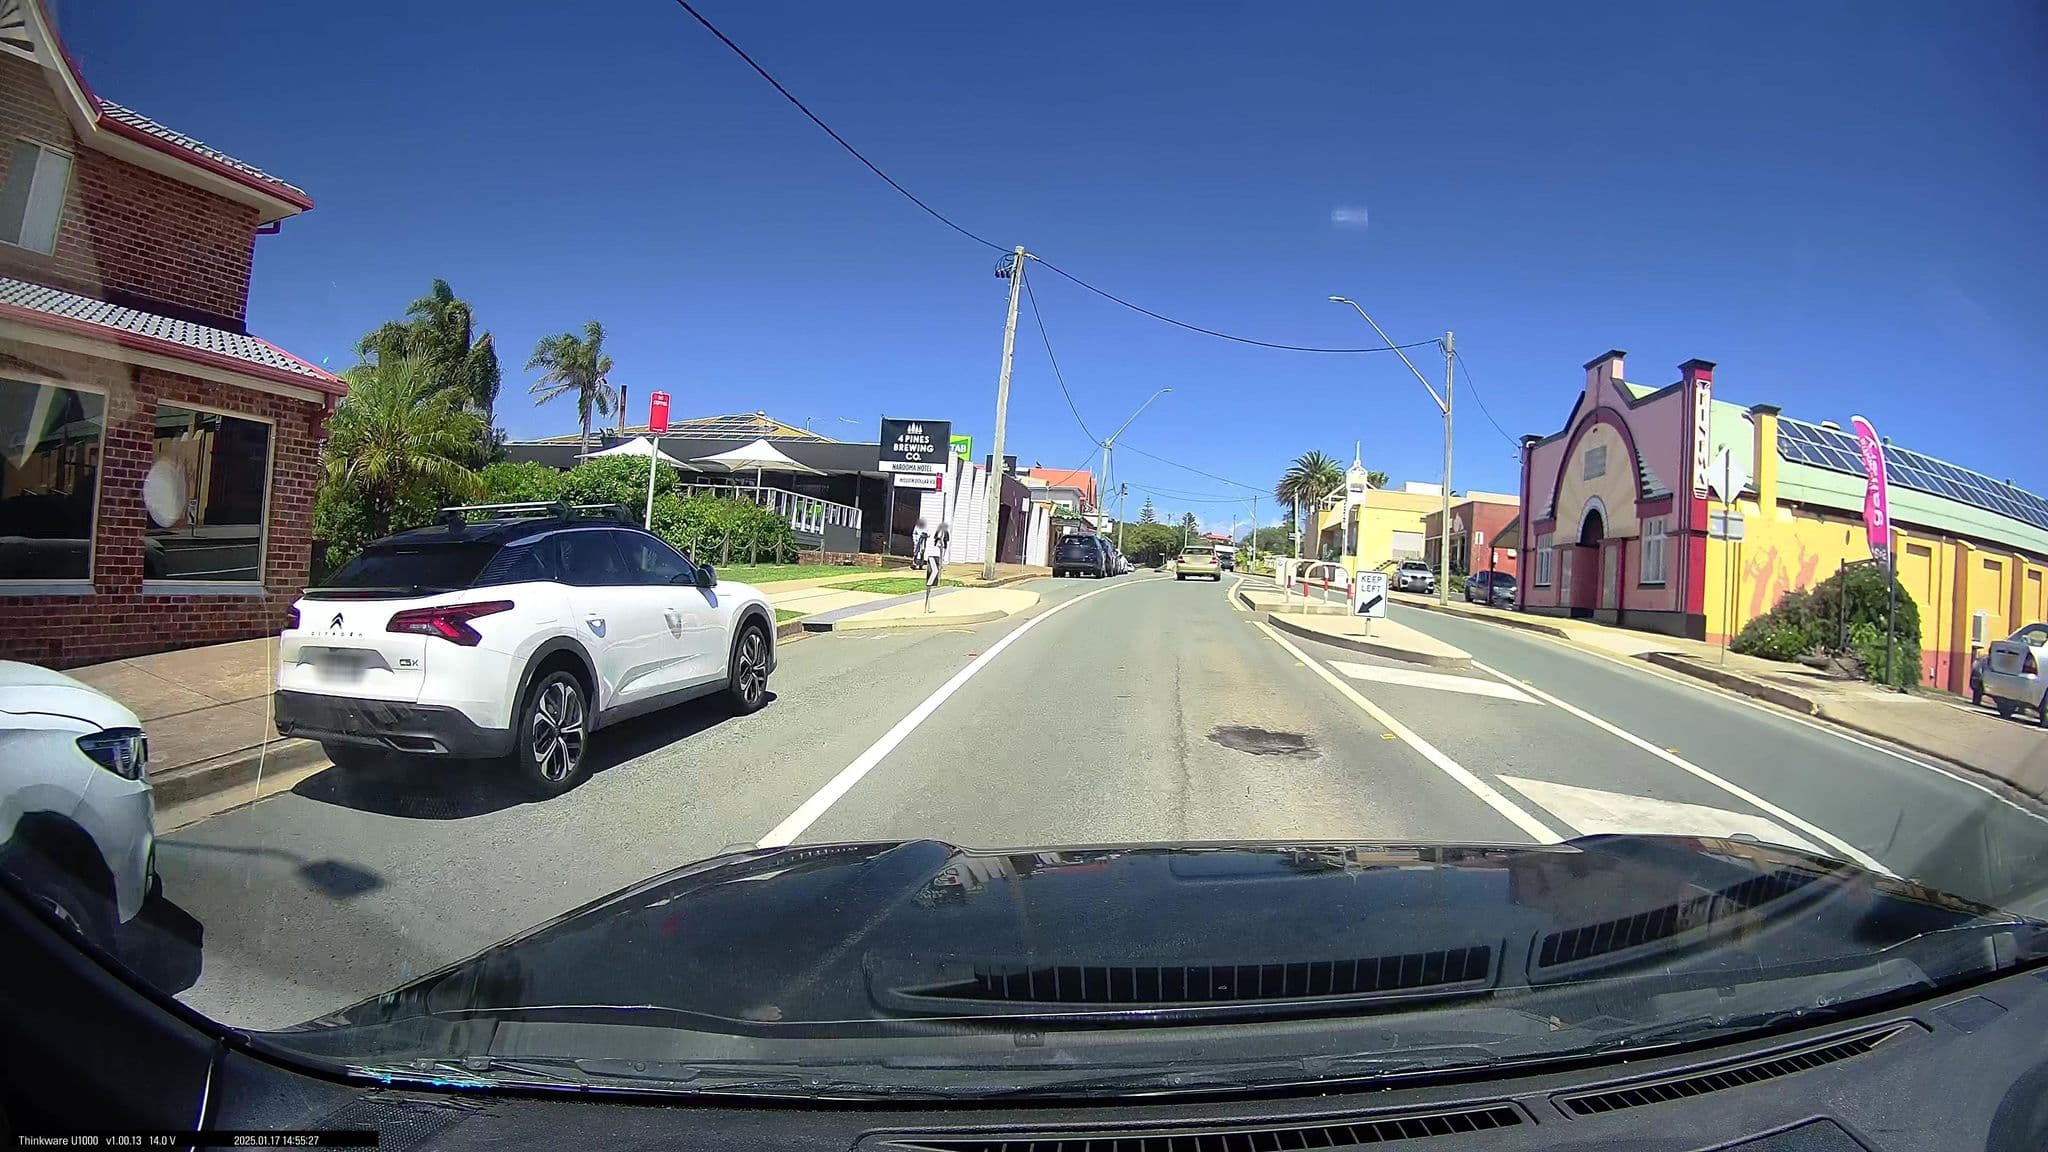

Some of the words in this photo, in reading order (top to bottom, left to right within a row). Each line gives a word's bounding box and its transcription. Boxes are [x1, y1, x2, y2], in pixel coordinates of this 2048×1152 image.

[898, 435, 904, 443] 4
[905, 435, 930, 444] PINES
[893, 443, 934, 453] BREWING
[950, 443, 967, 453] TAB
[905, 452, 922, 461] CO.
[892, 463, 916, 471] NAROOMA
[917, 464, 932, 472] HOTEL
[1361, 575, 1382, 583] KEEP
[1361, 584, 1382, 593] LEFT
